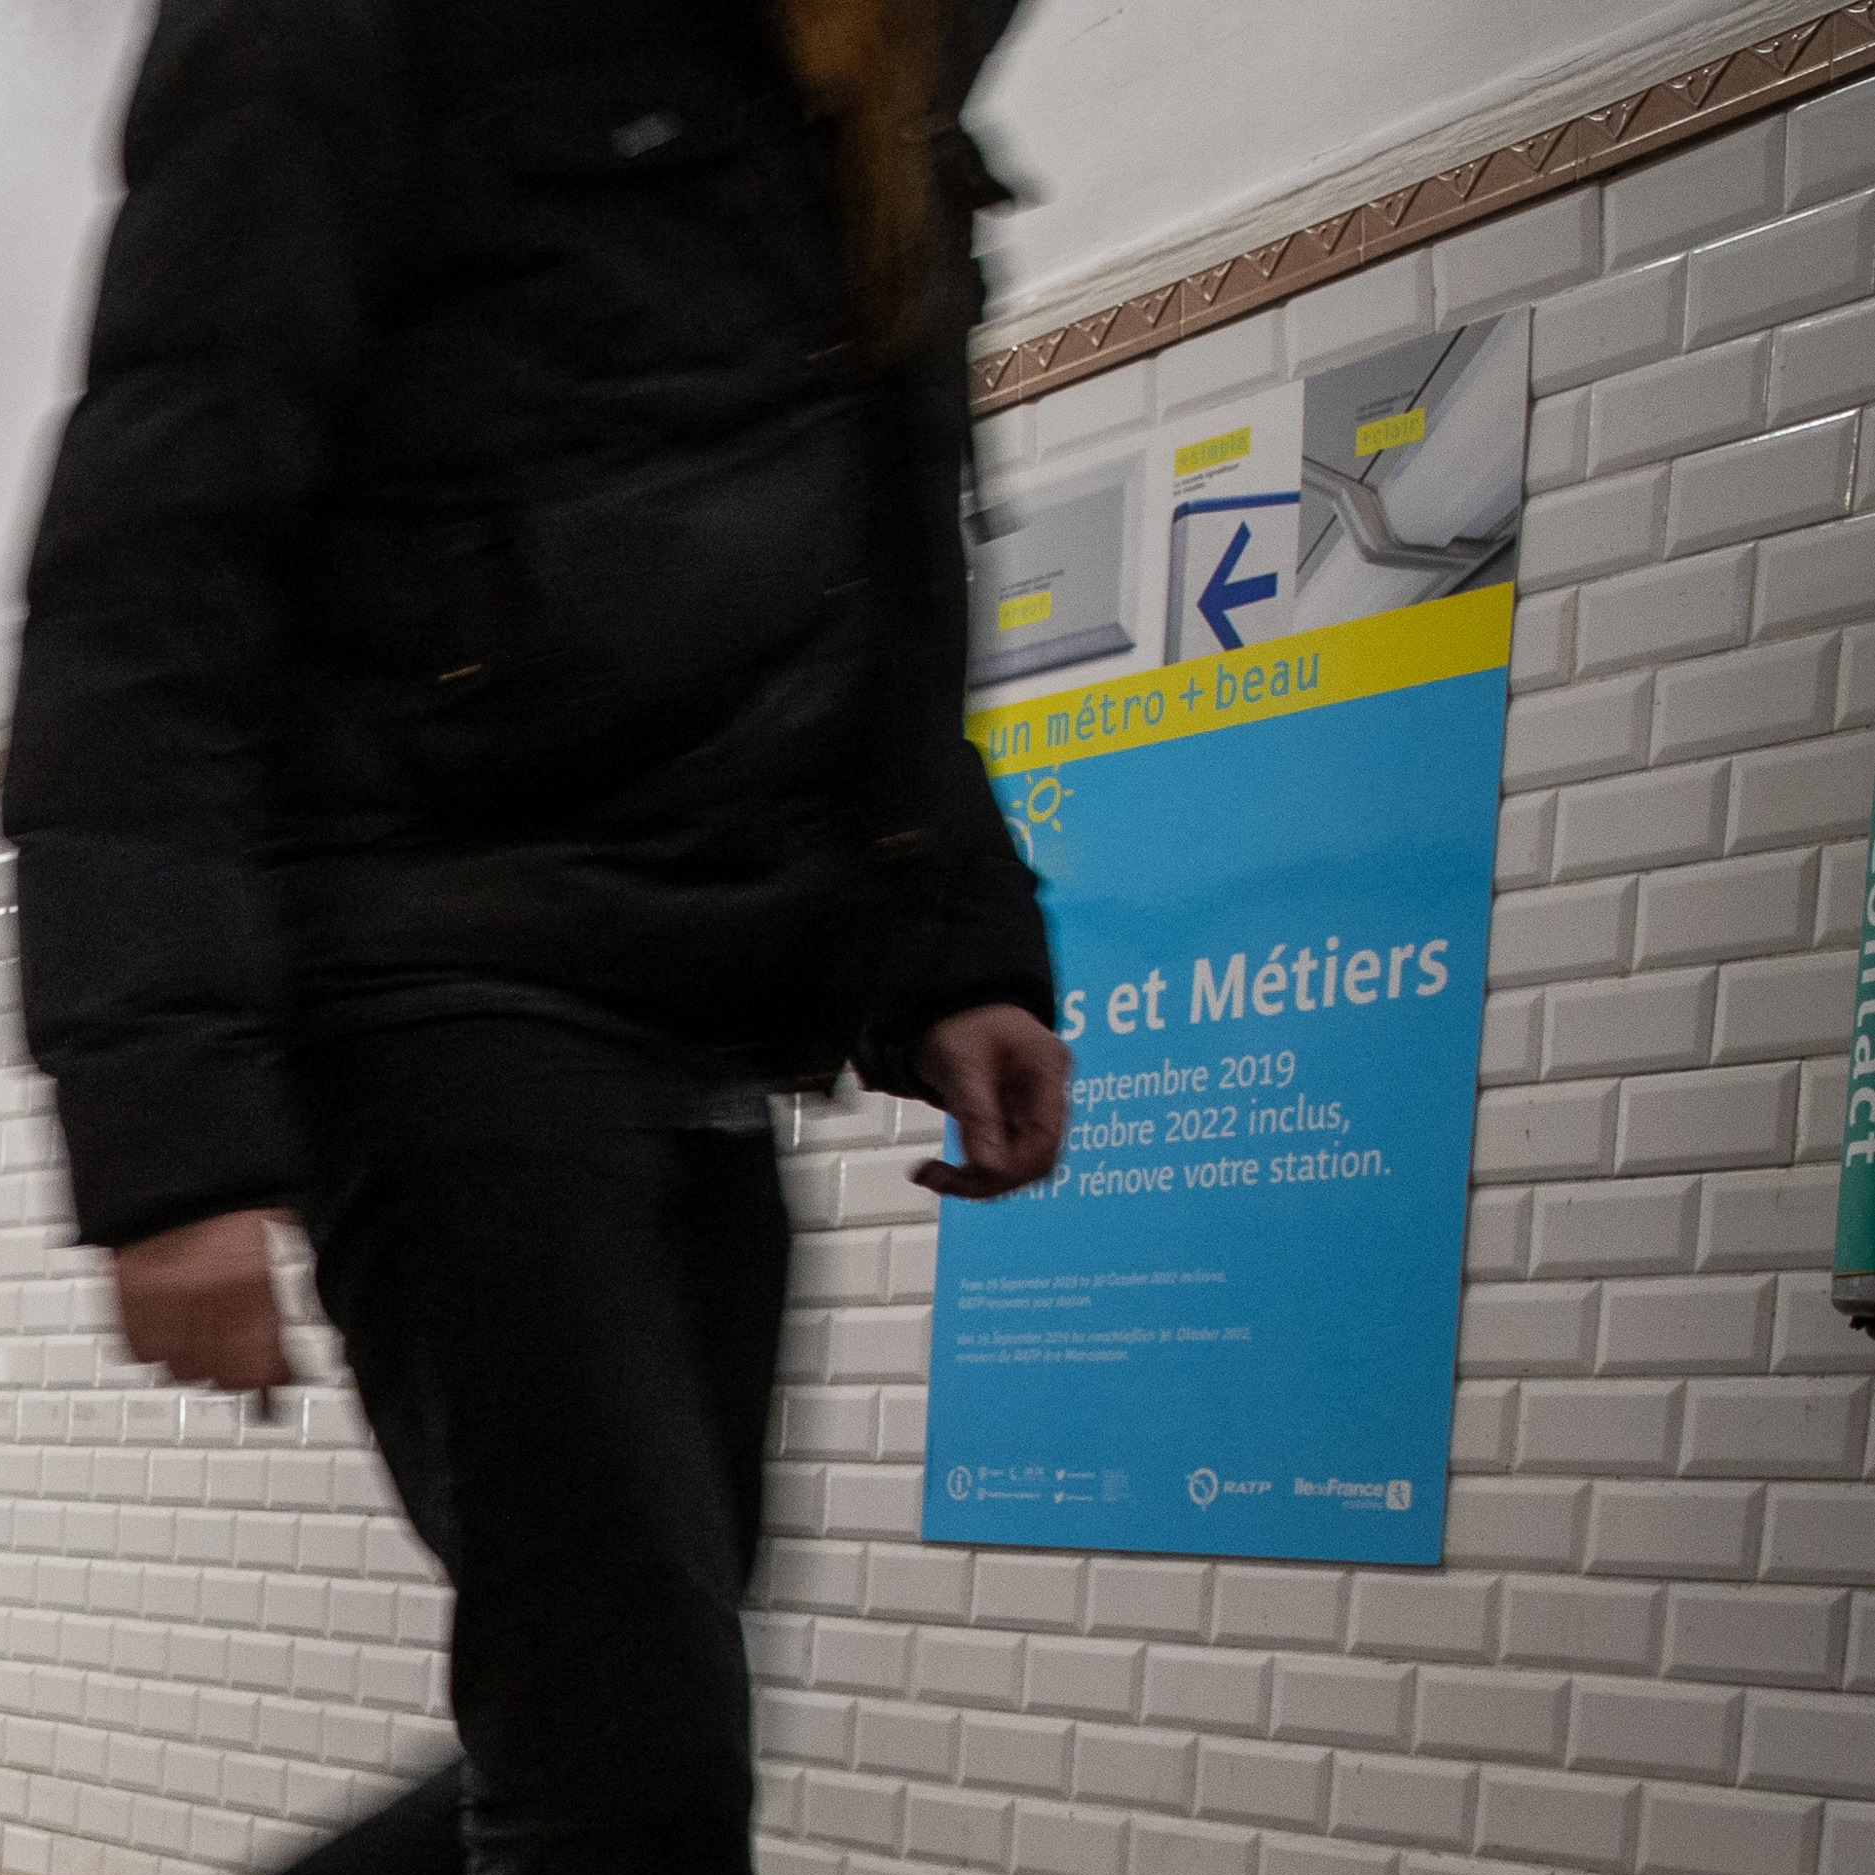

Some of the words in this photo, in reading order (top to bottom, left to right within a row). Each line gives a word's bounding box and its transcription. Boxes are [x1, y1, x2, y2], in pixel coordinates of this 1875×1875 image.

[988, 720, 1032, 760] un
[1045, 688, 1165, 748] métro
[1107, 968, 1167, 1034] et
[1189, 936, 1449, 1024] Métiers
[1219, 1050, 1296, 1088] 2019
[1067, 1110, 1155, 1151] ctobre
[1164, 1105, 1238, 1142] 2022
[1250, 1093, 1350, 1135] inclus,
[1080, 1159, 1175, 1197] rénove
[1184, 1155, 1259, 1190] votre
[1268, 1140, 1393, 1185] station.
